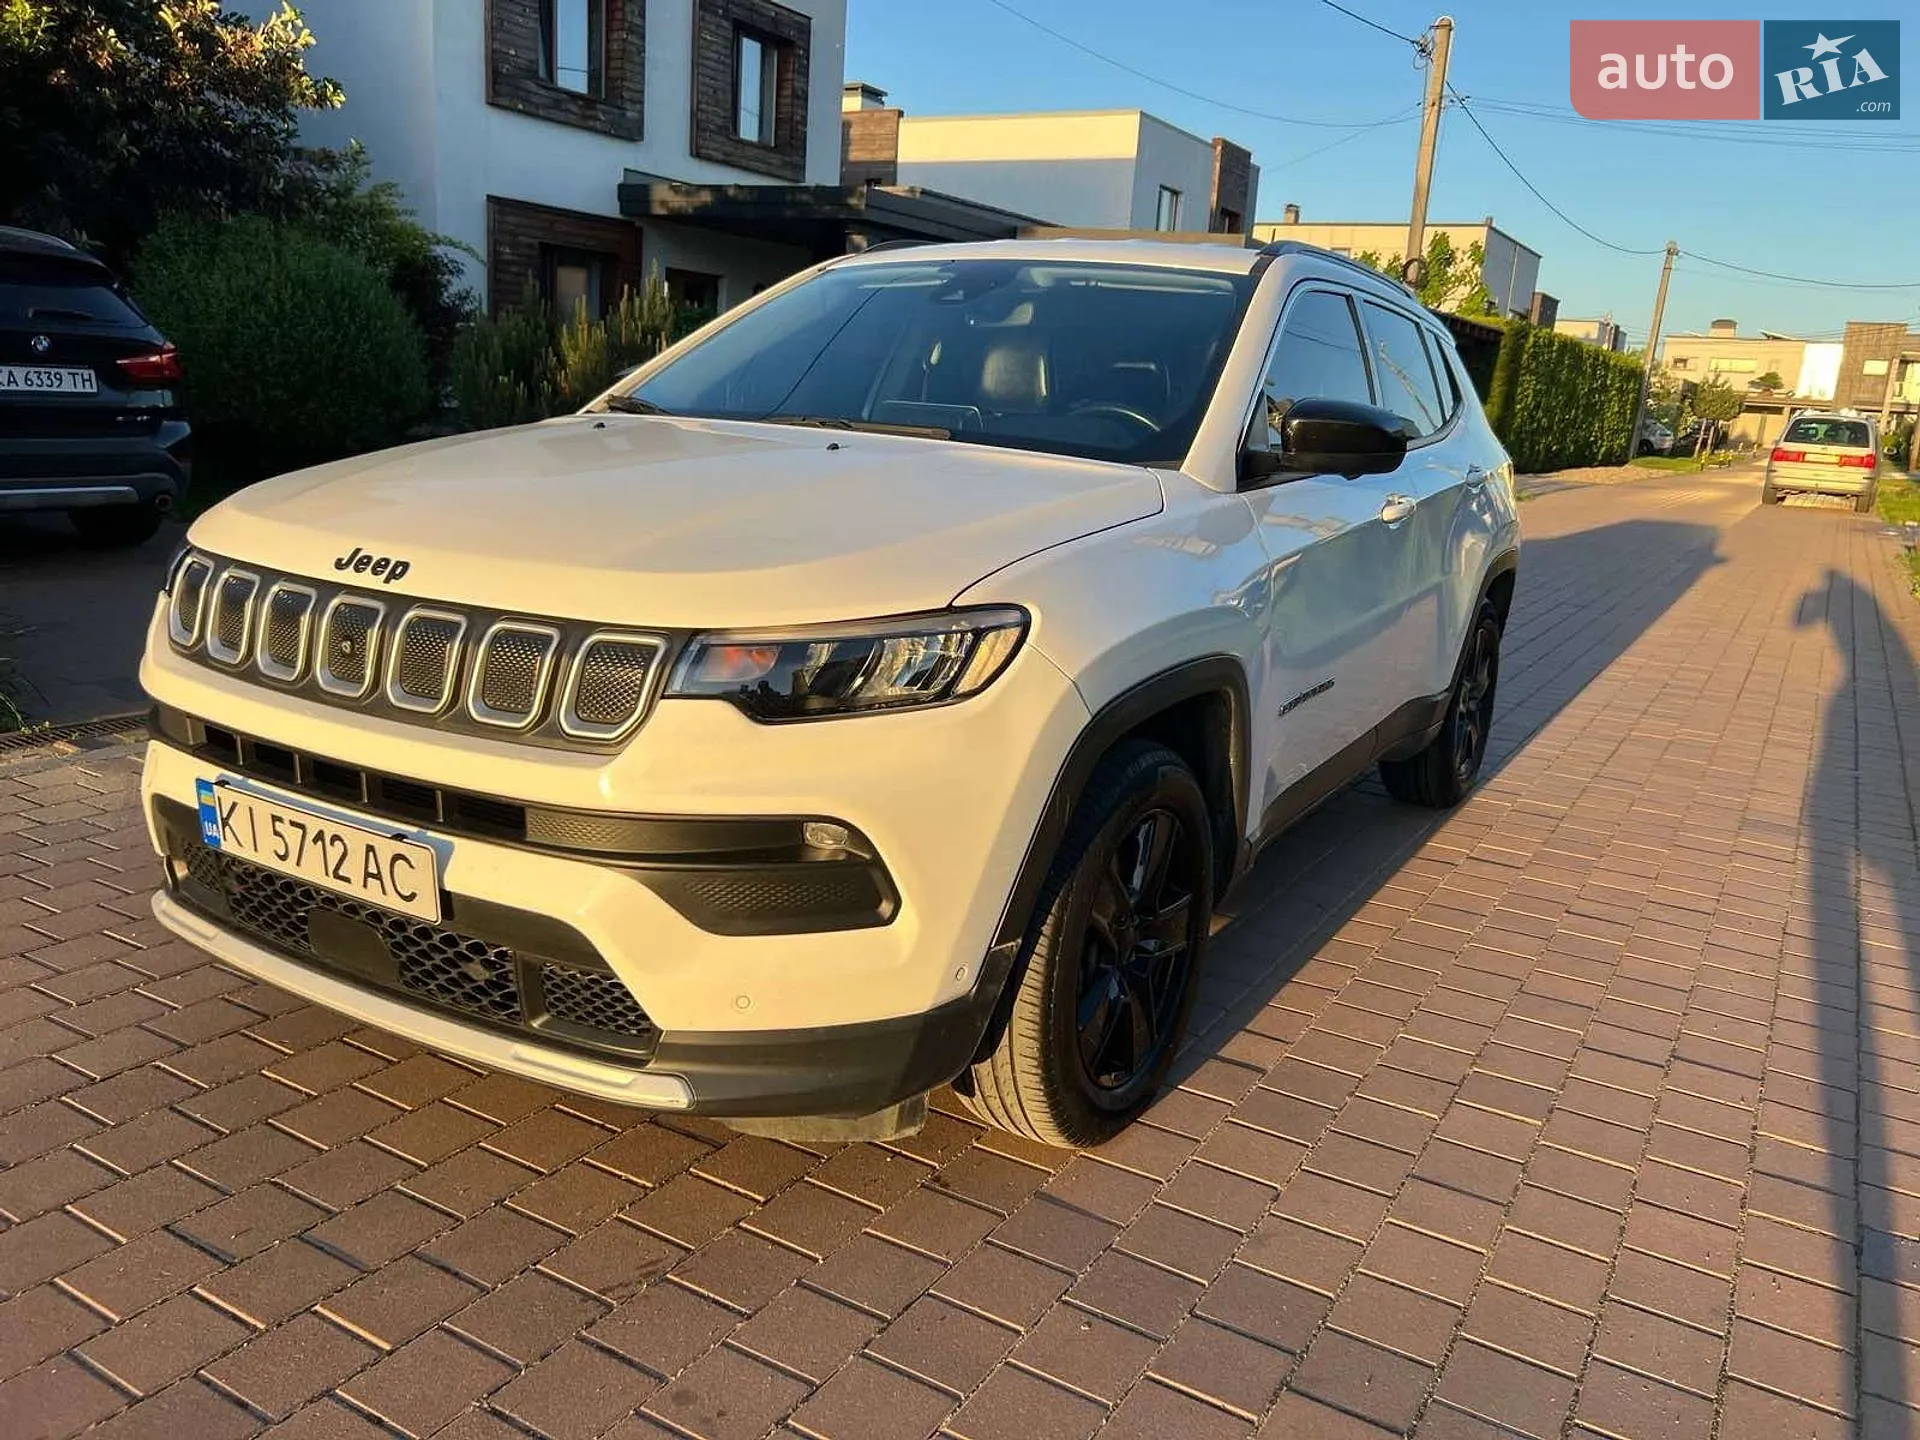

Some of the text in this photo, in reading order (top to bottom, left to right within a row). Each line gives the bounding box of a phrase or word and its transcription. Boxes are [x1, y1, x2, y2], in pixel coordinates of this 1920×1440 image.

[0, 370, 94, 389] A 6339 TH
[334, 547, 411, 584] Jeep
[204, 820, 220, 840] UA
[217, 795, 418, 903] KI 5712 AC
